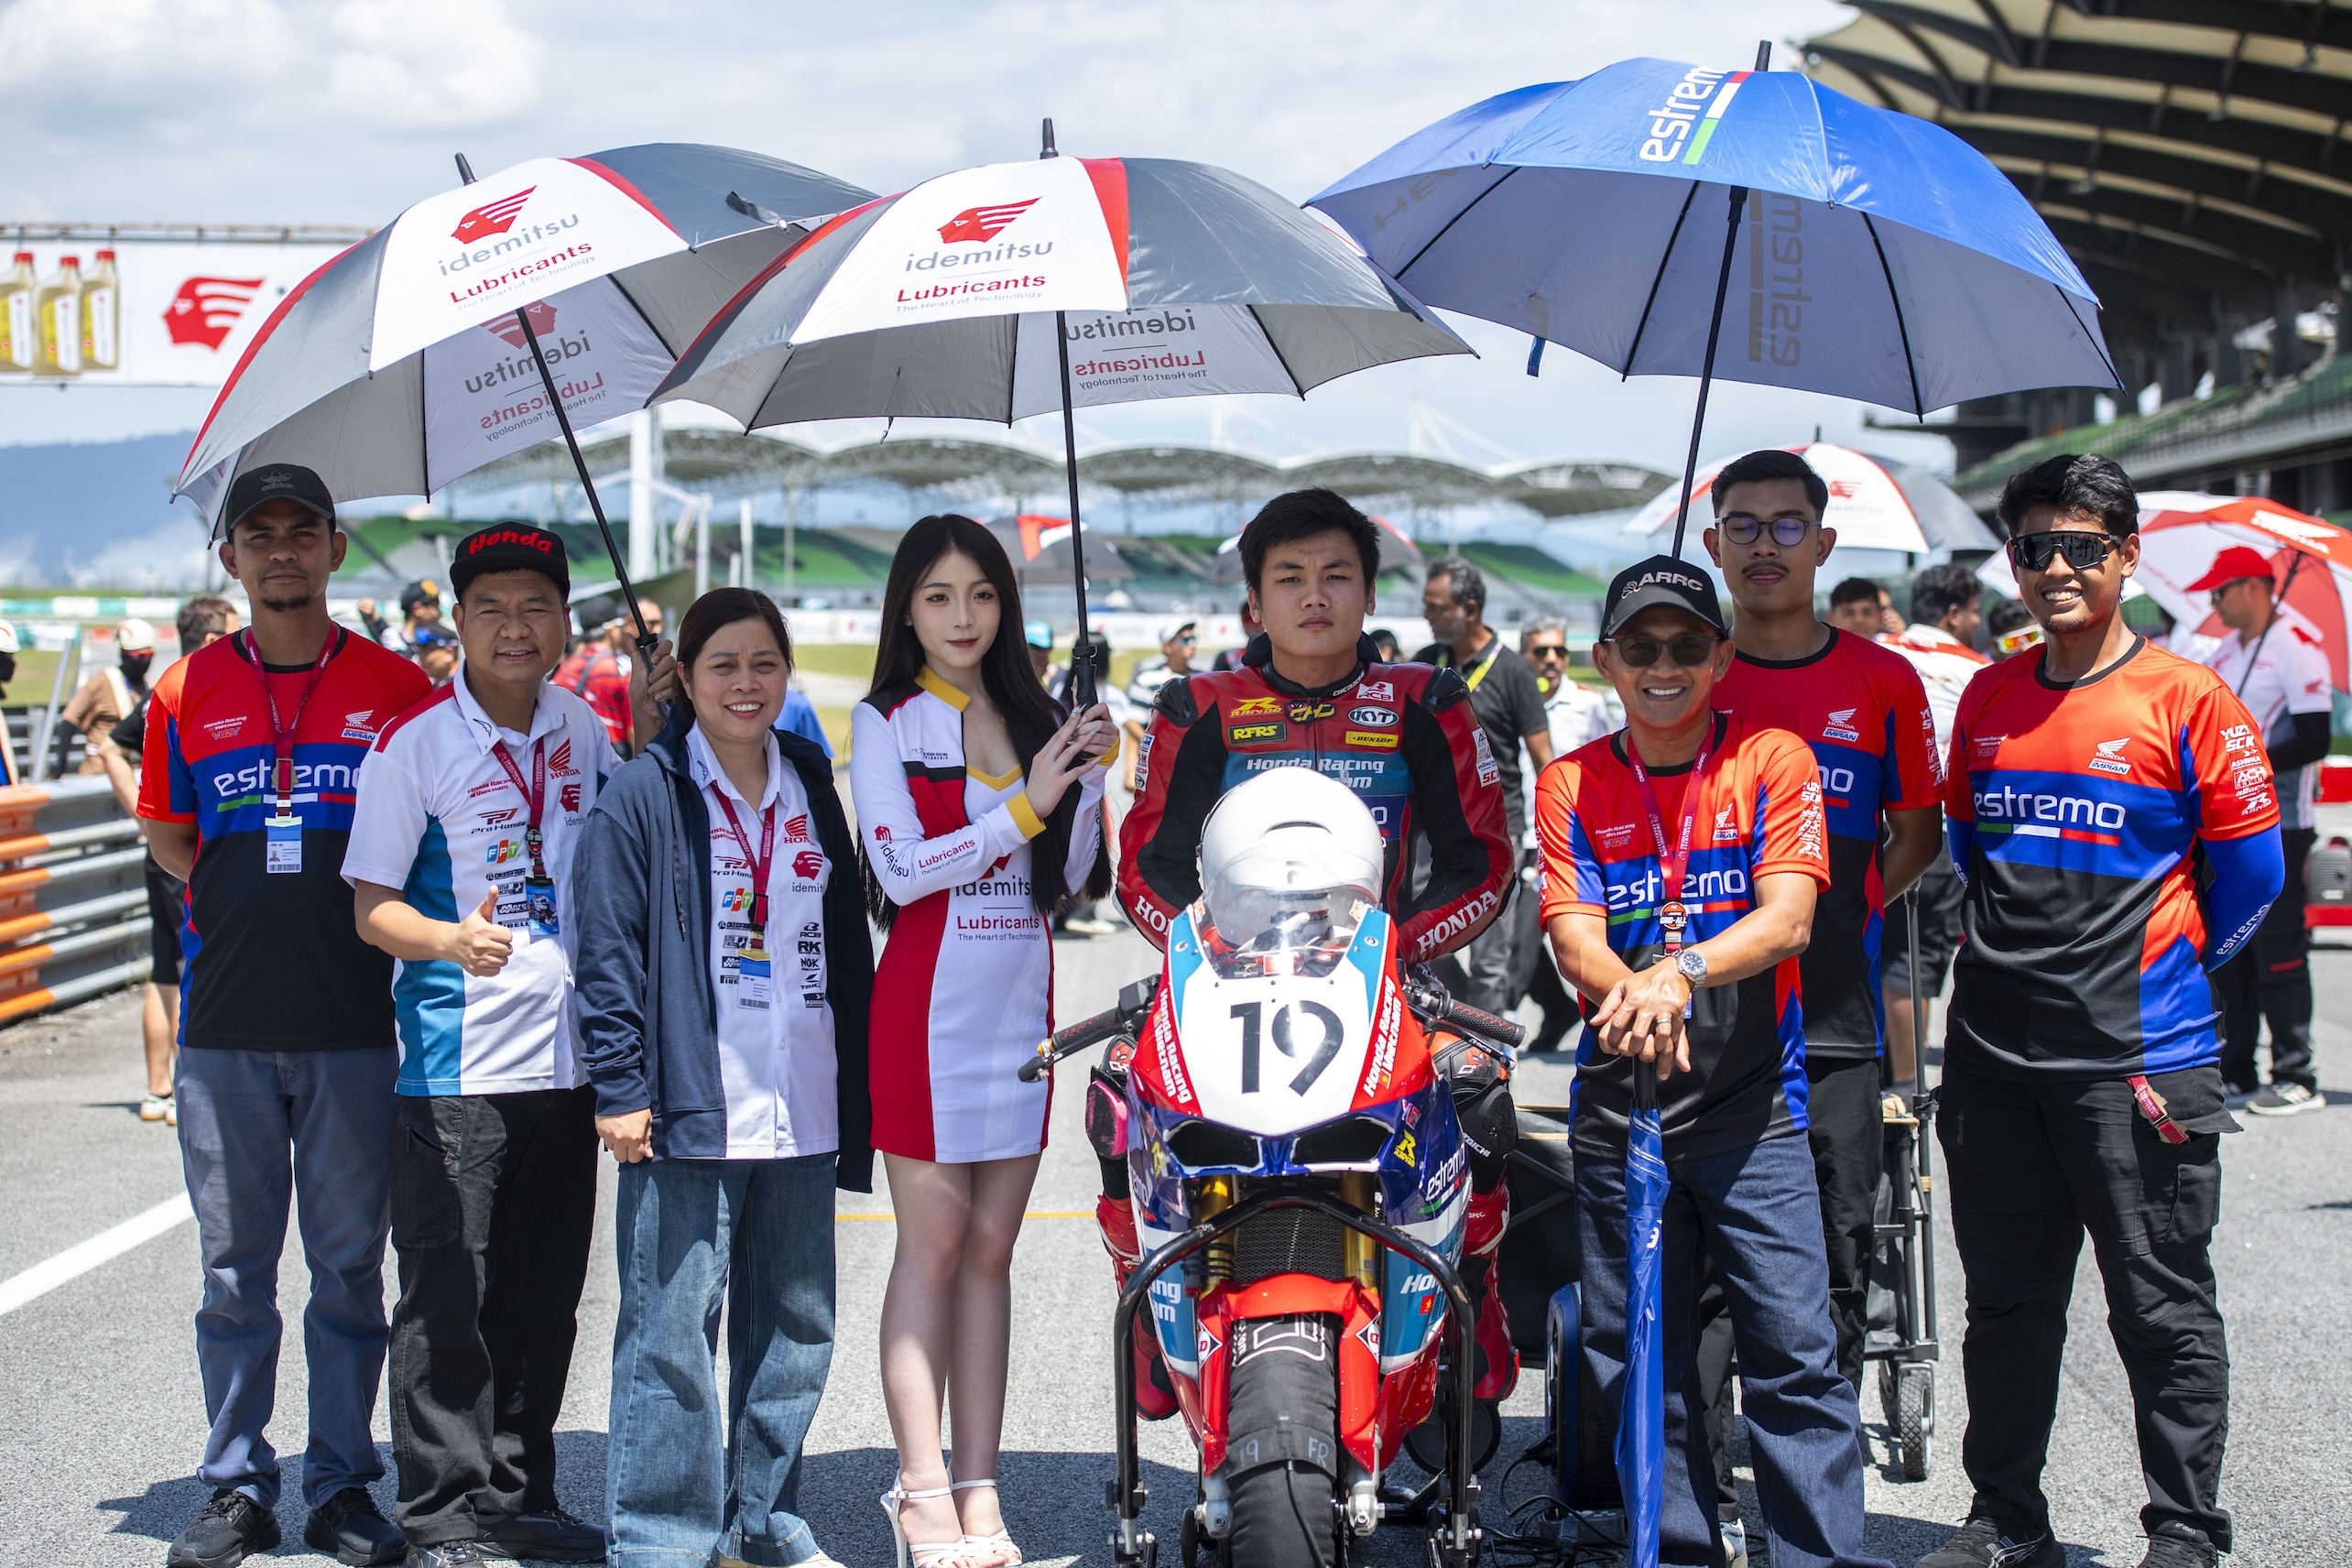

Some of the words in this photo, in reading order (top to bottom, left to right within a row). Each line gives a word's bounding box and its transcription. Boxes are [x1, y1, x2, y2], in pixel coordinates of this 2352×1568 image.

[438, 213, 579, 276] idemitsu
[905, 242, 1052, 272] idemitsu
[451, 243, 593, 303] Lubricants
[458, 299, 478, 311] The
[480, 286, 513, 303] Heart
[515, 280, 527, 290] of
[528, 256, 595, 284] Technology
[897, 275, 1046, 303] Lubricants
[920, 299, 954, 310] Heart
[974, 291, 1043, 302] Technology
[468, 531, 552, 555] Honda
[1639, 572, 1704, 591] ARRC
[1356, 711, 1393, 723] KYT
[1827, 721, 1856, 731] HONDA
[345, 723, 375, 731] HONDA
[1233, 724, 1278, 740] RFRS
[1824, 730, 1857, 741] IMPIAN
[2226, 735, 2255, 752] SCK
[1247, 757, 1312, 770] Honda
[1318, 758, 1386, 774] Racing
[2095, 751, 2127, 762] HONDA
[2231, 756, 2262, 768] ASHUKA
[550, 768, 581, 779] HONDA
[2091, 762, 2127, 773] IMPIAN
[2237, 766, 2267, 784] ACH
[1974, 786, 2127, 830] estremo
[494, 821, 527, 831] Honda
[487, 843, 518, 861] FPT
[919, 839, 975, 869] Lubricants
[931, 863, 945, 873] Heart
[951, 848, 978, 865] Technology
[723, 892, 752, 908] FPT
[957, 915, 1040, 930] Lubricants
[1416, 889, 1499, 954] HONDA
[2216, 904, 2270, 955] estremo
[1007, 933, 1040, 942] Technology
[798, 942, 822, 953] RK
[800, 958, 820, 968] NGK
[1363, 1035, 1386, 1098] Honda
[1382, 975, 1396, 1037] Racing
[1382, 996, 1402, 1073] Vietnam
[1160, 988, 1172, 1042] Honda
[1167, 1041, 1192, 1105] Racing
[1230, 999, 1345, 1097] 19
[1153, 1024, 1177, 1097] Vietnam
[1425, 1144, 1465, 1201] estremo
[1240, 1438, 1258, 1467] 19
[1308, 1436, 1329, 1468] FR
